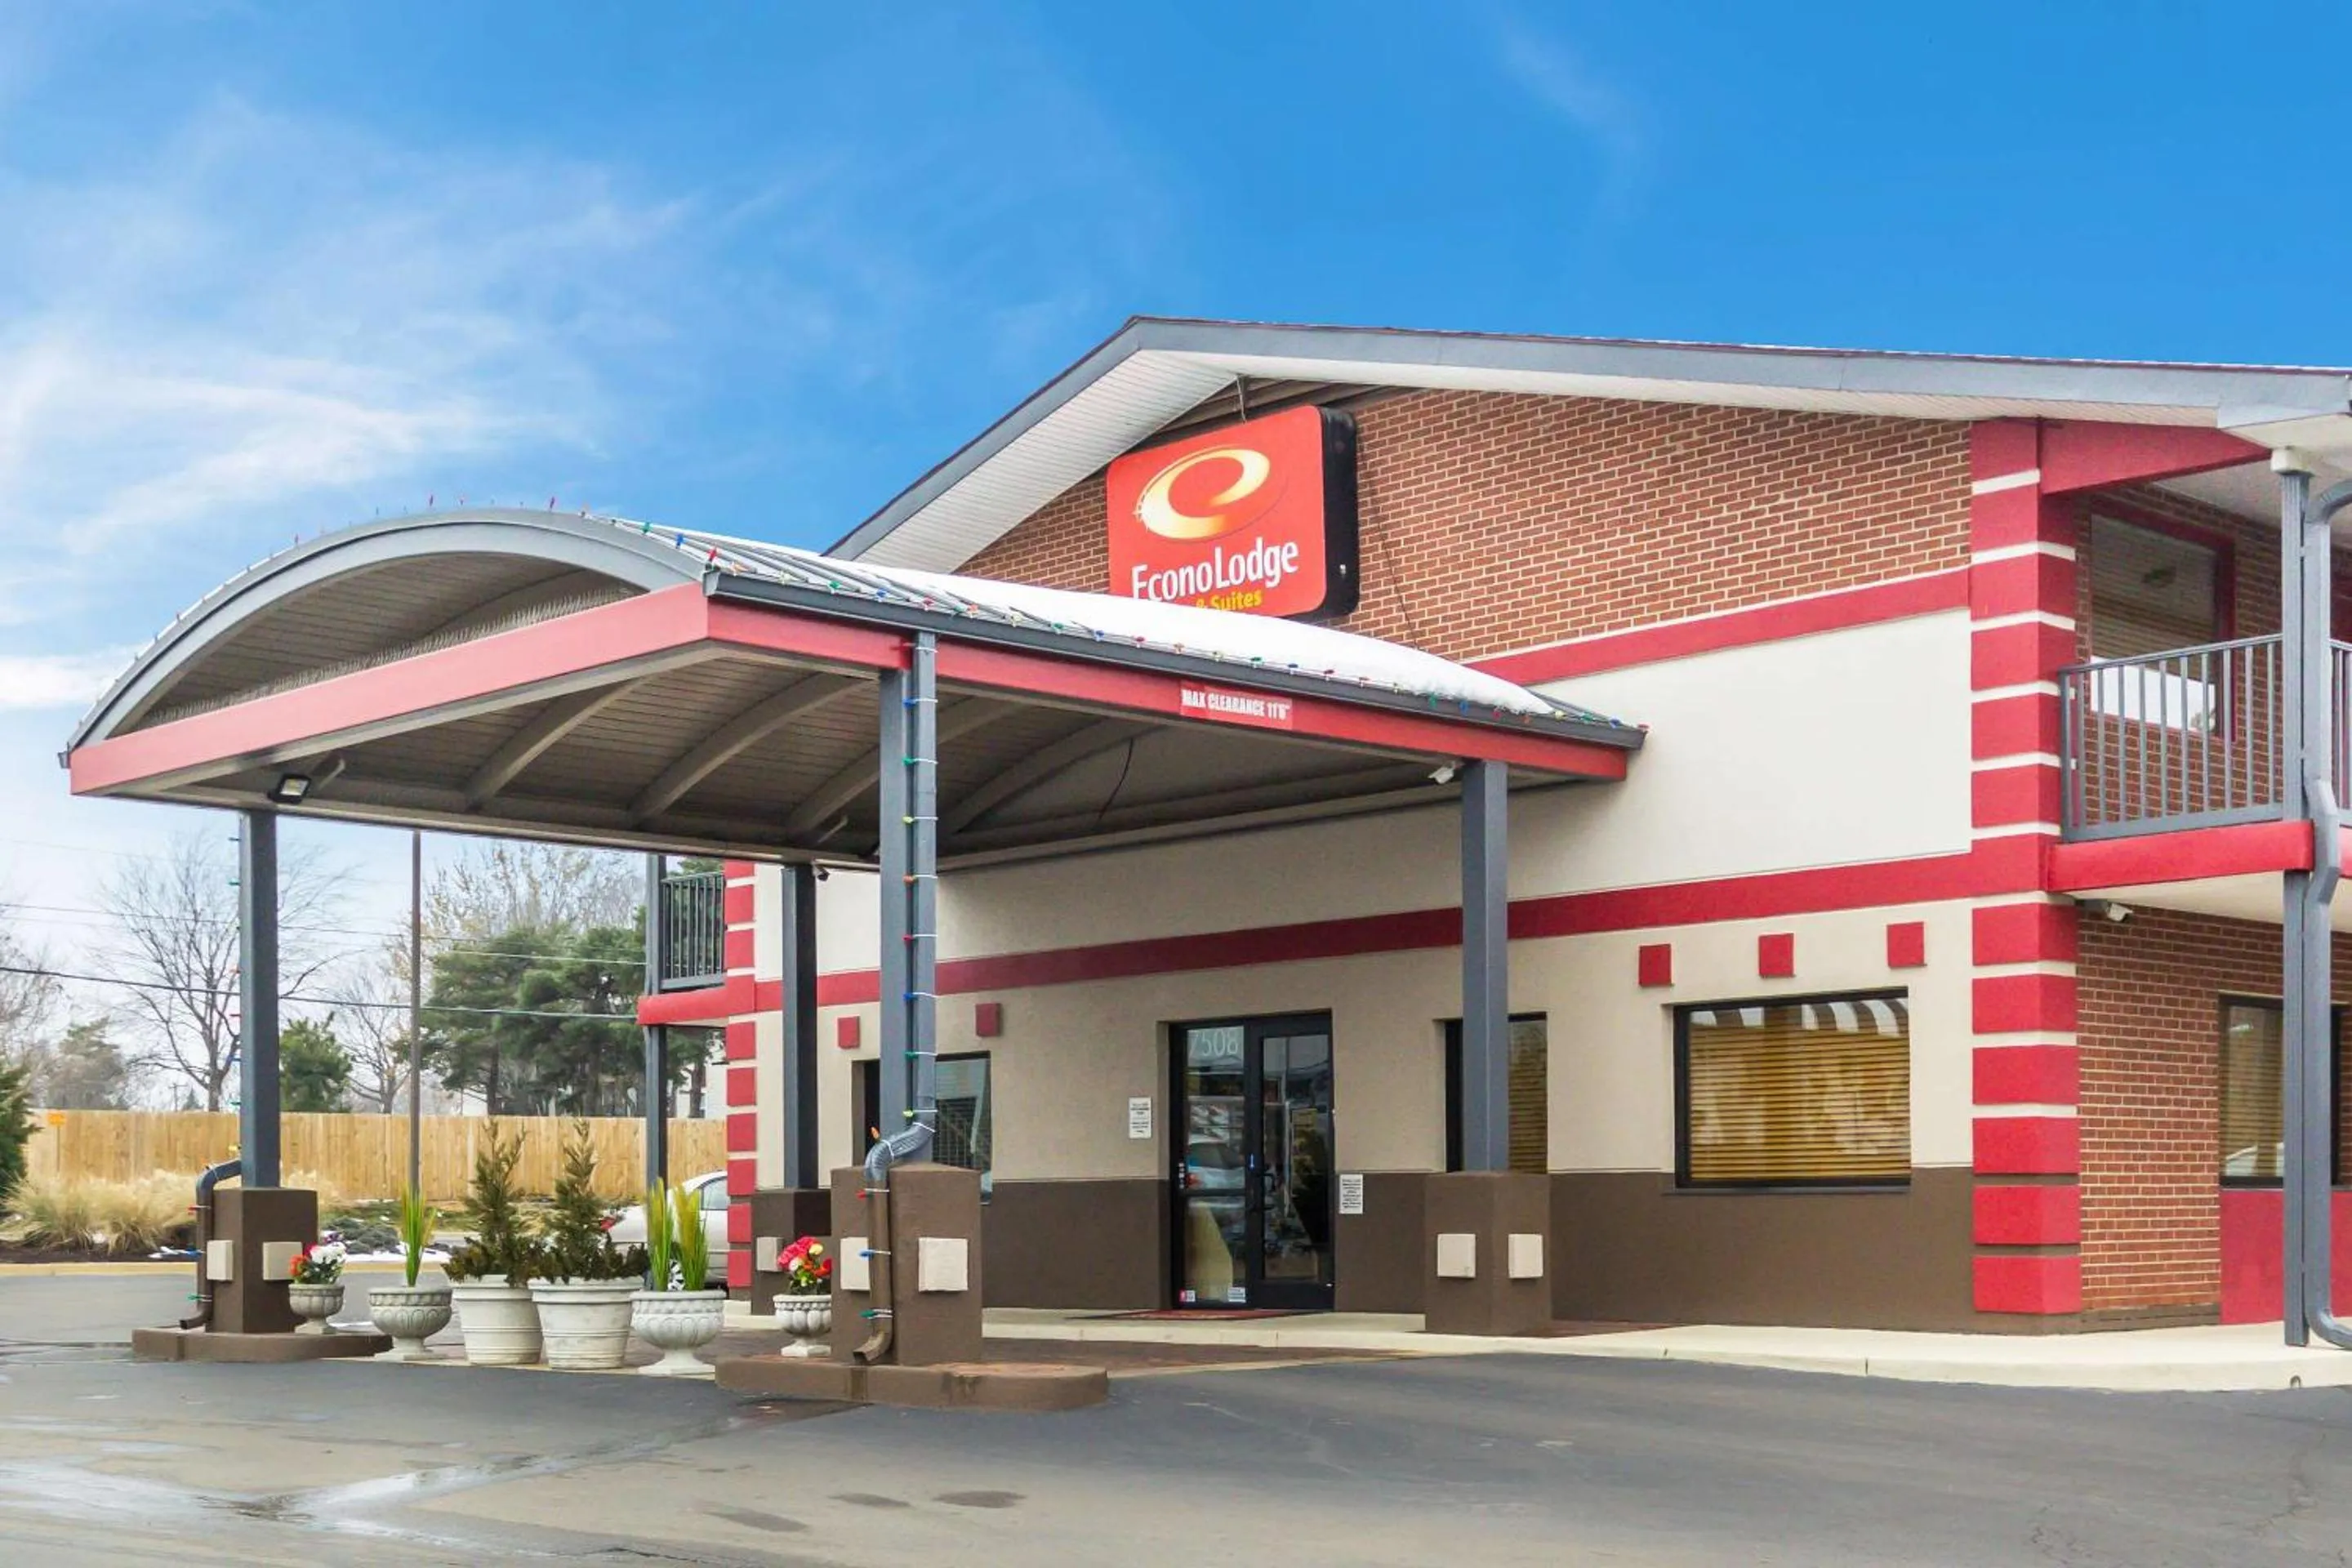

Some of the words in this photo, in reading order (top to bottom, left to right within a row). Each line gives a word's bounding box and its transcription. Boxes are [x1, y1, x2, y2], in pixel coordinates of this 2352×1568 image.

[1212, 590, 1262, 610] Suites
[1182, 689, 1206, 708] MAX
[1207, 693, 1265, 717] CLEARANCE
[1188, 1029, 1238, 1057] 7508
